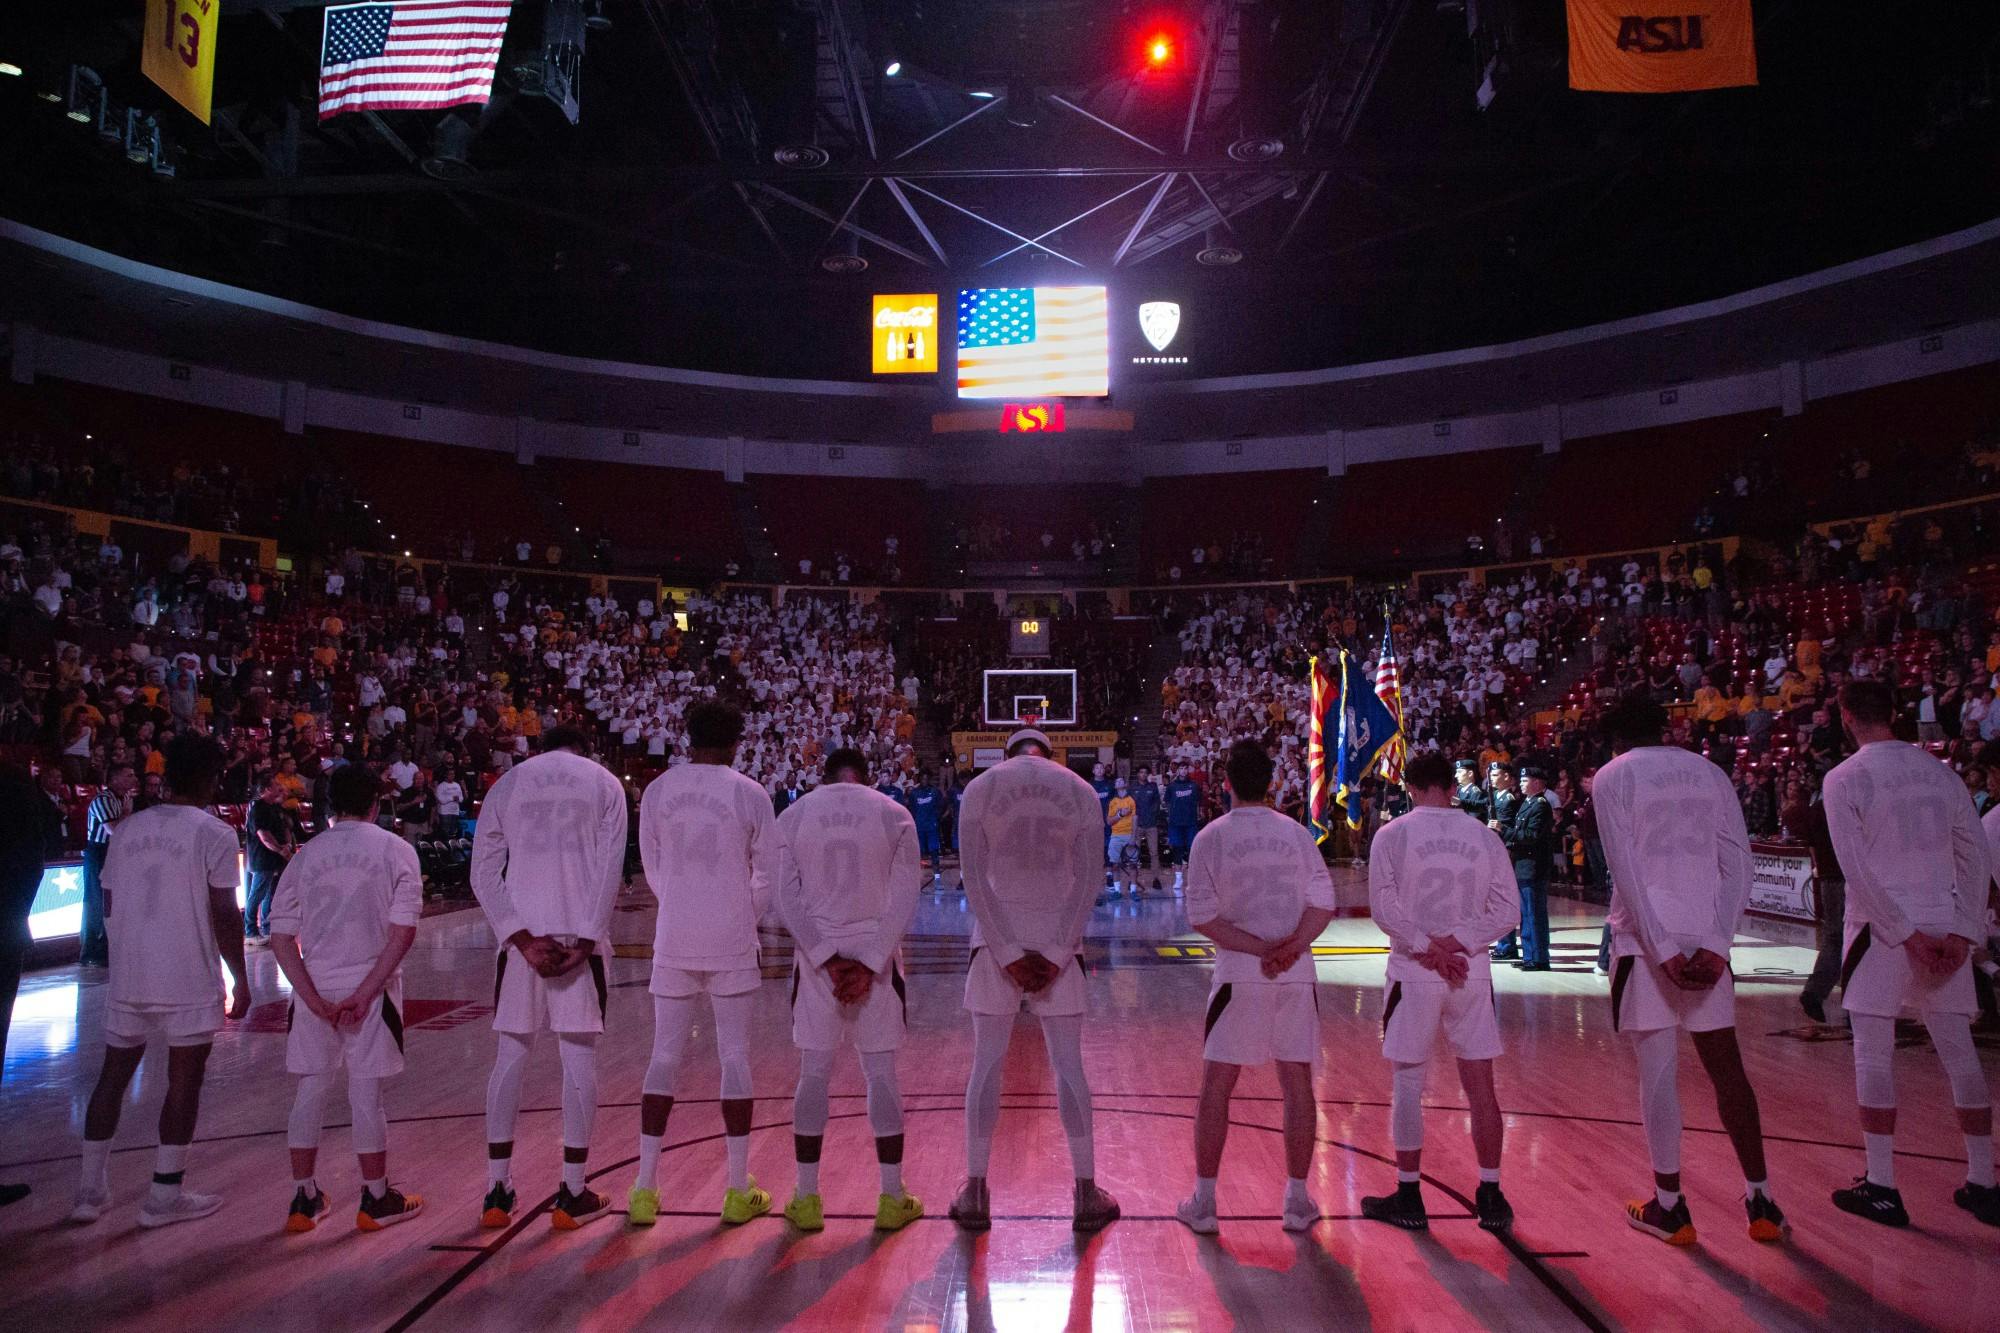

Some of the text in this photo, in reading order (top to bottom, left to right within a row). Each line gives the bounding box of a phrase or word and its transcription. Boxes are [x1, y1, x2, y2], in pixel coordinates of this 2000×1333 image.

[164, 0, 200, 69] 13
[1616, 15, 1707, 53] ASU
[1001, 404, 1065, 433] ASU
[670, 822, 722, 877] 14
[824, 838, 860, 897] 0
[996, 816, 1070, 870] 45
[1752, 855, 1803, 872] upport your
[1415, 868, 1477, 926] 21
[1753, 873, 1796, 890] ommunity
